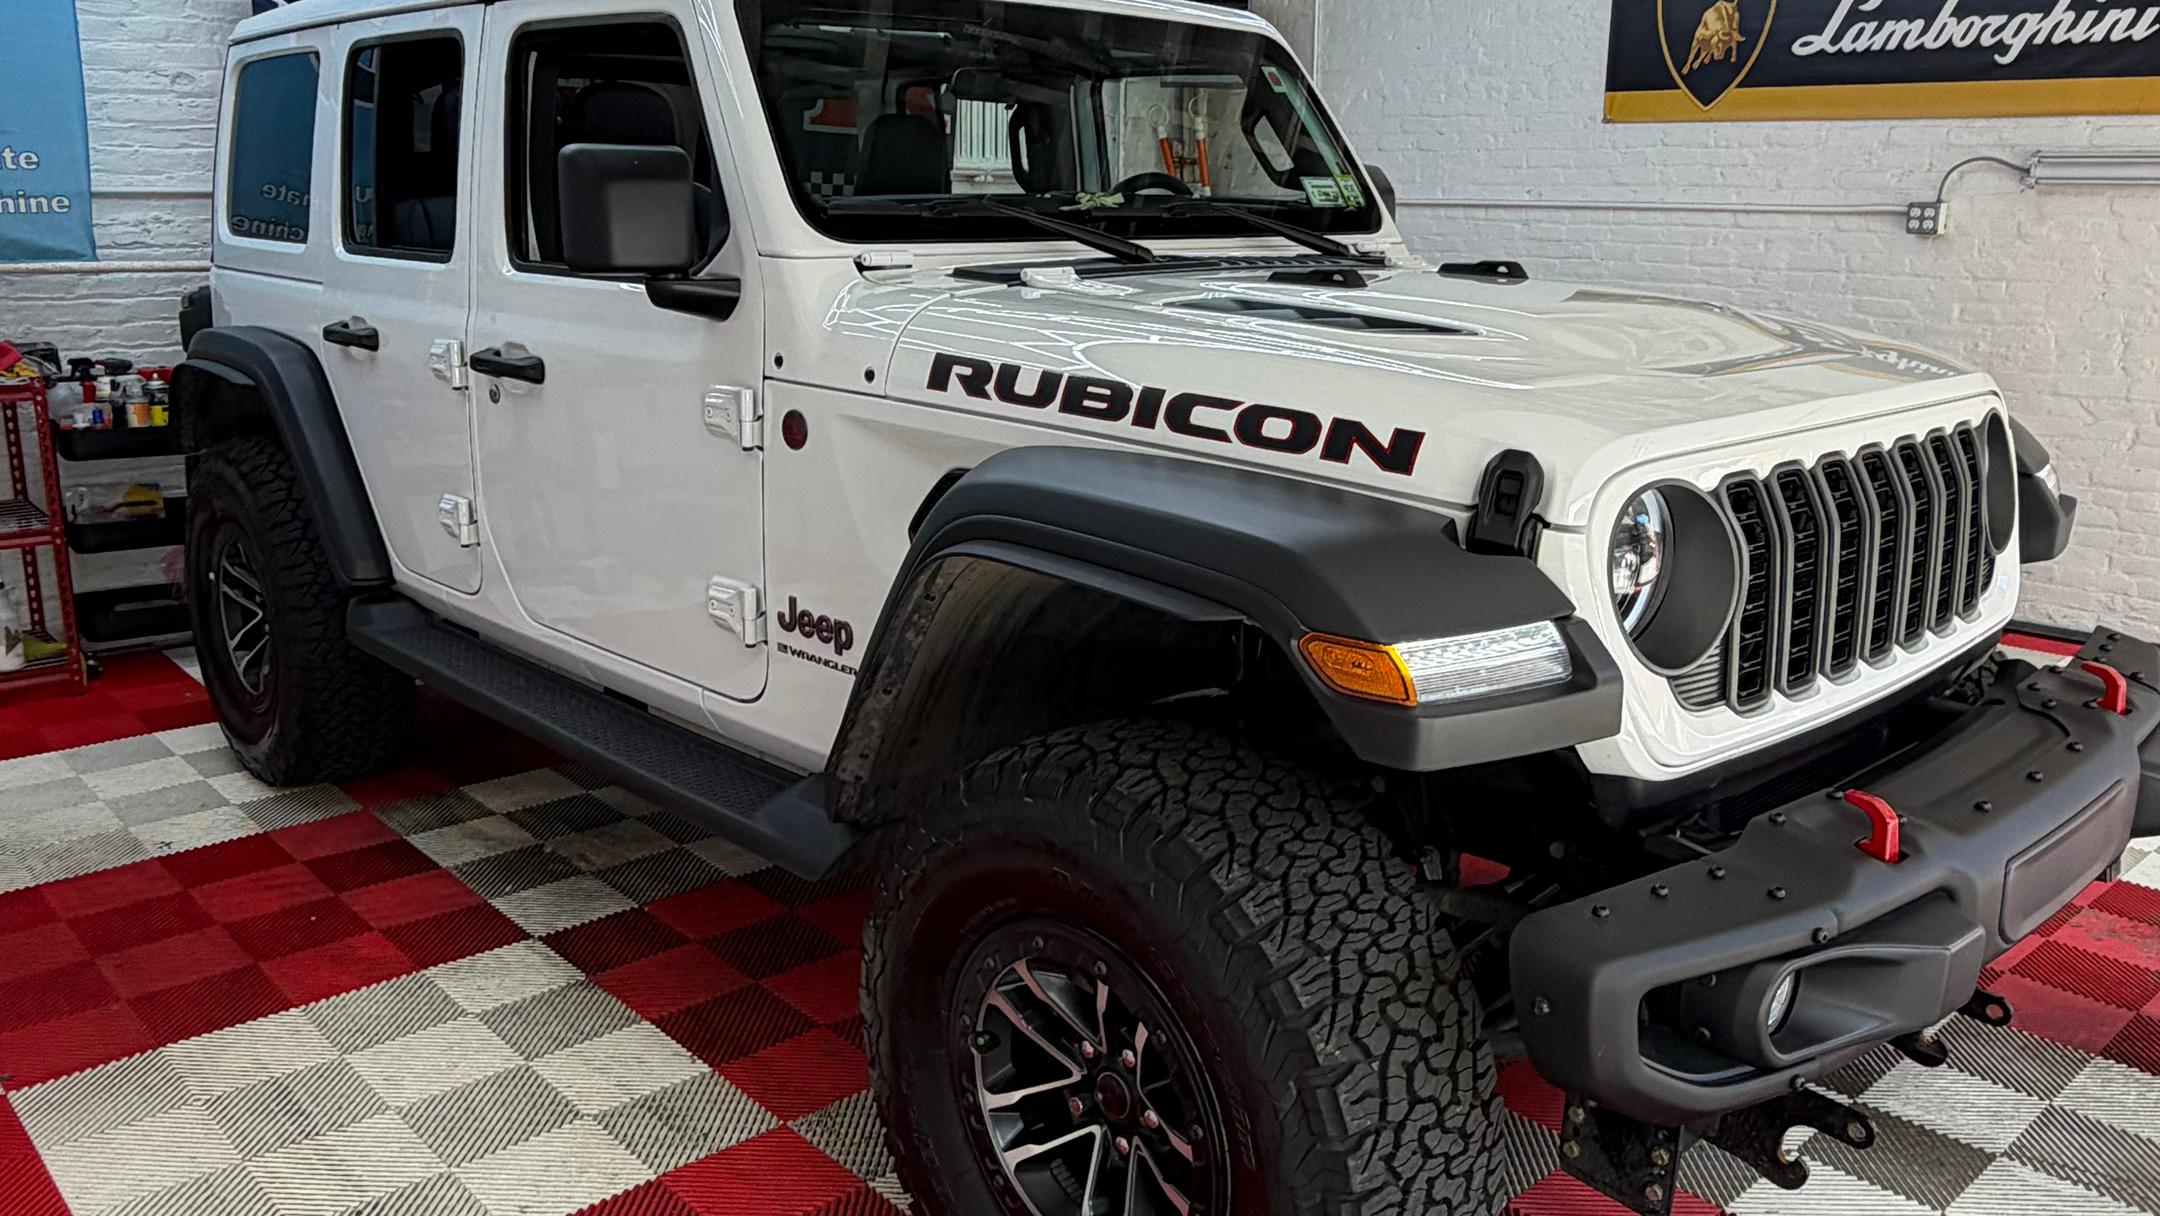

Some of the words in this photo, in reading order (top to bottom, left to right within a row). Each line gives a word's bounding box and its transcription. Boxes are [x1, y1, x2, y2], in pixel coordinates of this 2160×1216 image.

[1791, 0, 2160, 64] Lamborghini
[0, 145, 39, 170] te
[926, 352, 1426, 476] RUBICON
[777, 595, 854, 656] Jeep
[789, 645, 858, 677] WRANGLER
